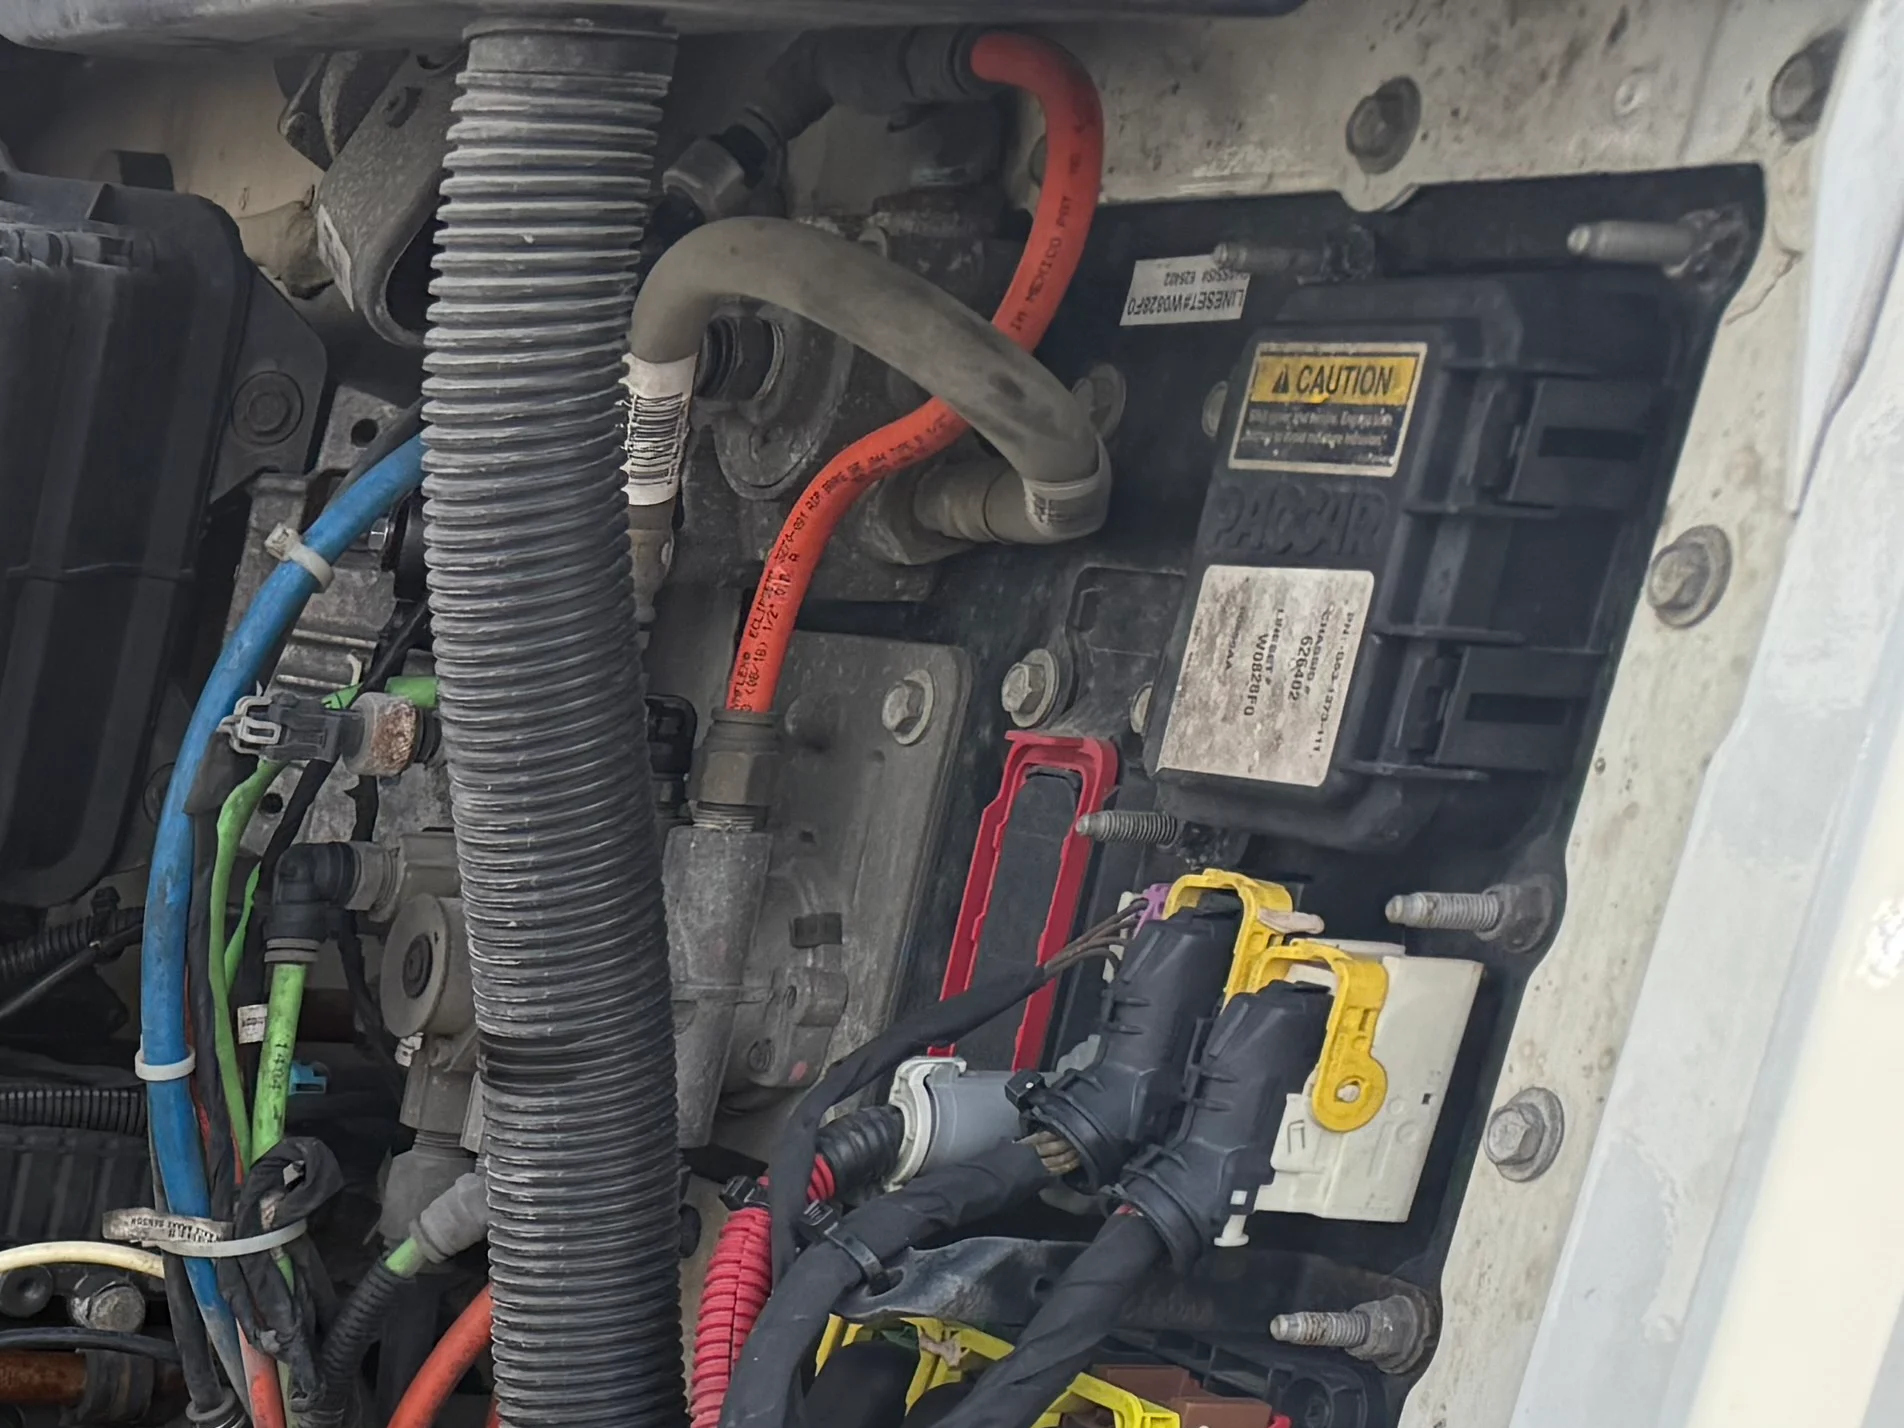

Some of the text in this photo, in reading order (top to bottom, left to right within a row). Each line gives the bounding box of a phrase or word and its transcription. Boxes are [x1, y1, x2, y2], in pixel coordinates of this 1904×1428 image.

[1296, 364, 1393, 396] CAUTION
[1215, 485, 1384, 556] PACCAR
[1243, 633, 1269, 717] W0828F0
[1288, 635, 1314, 702] 626402
